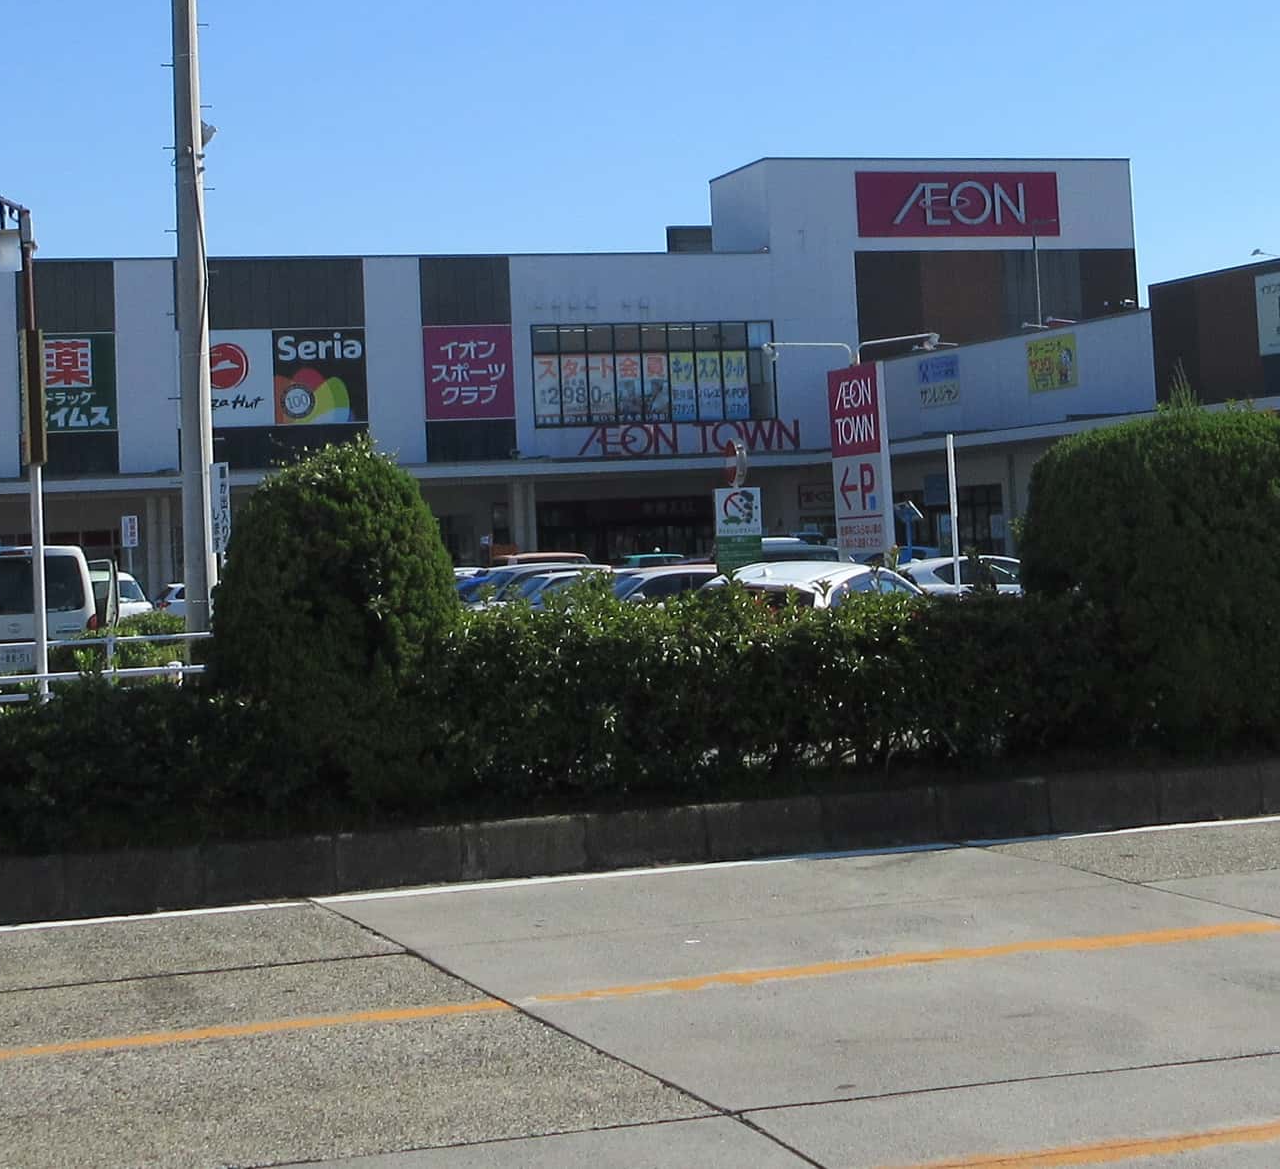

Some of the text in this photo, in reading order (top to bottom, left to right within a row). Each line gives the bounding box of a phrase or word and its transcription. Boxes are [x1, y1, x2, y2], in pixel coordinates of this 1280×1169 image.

[277, 332, 363, 361] Seria
[439, 340, 497, 360] イオン
[44, 339, 91, 387] 薬
[431, 363, 507, 383] スポーツ
[231, 394, 265, 410] Hut
[441, 385, 498, 406] クラブ
[44, 407, 110, 427] イムス
[834, 413, 875, 446] TOWN
[694, 419, 801, 454] TOWN
[859, 463, 875, 511] P
